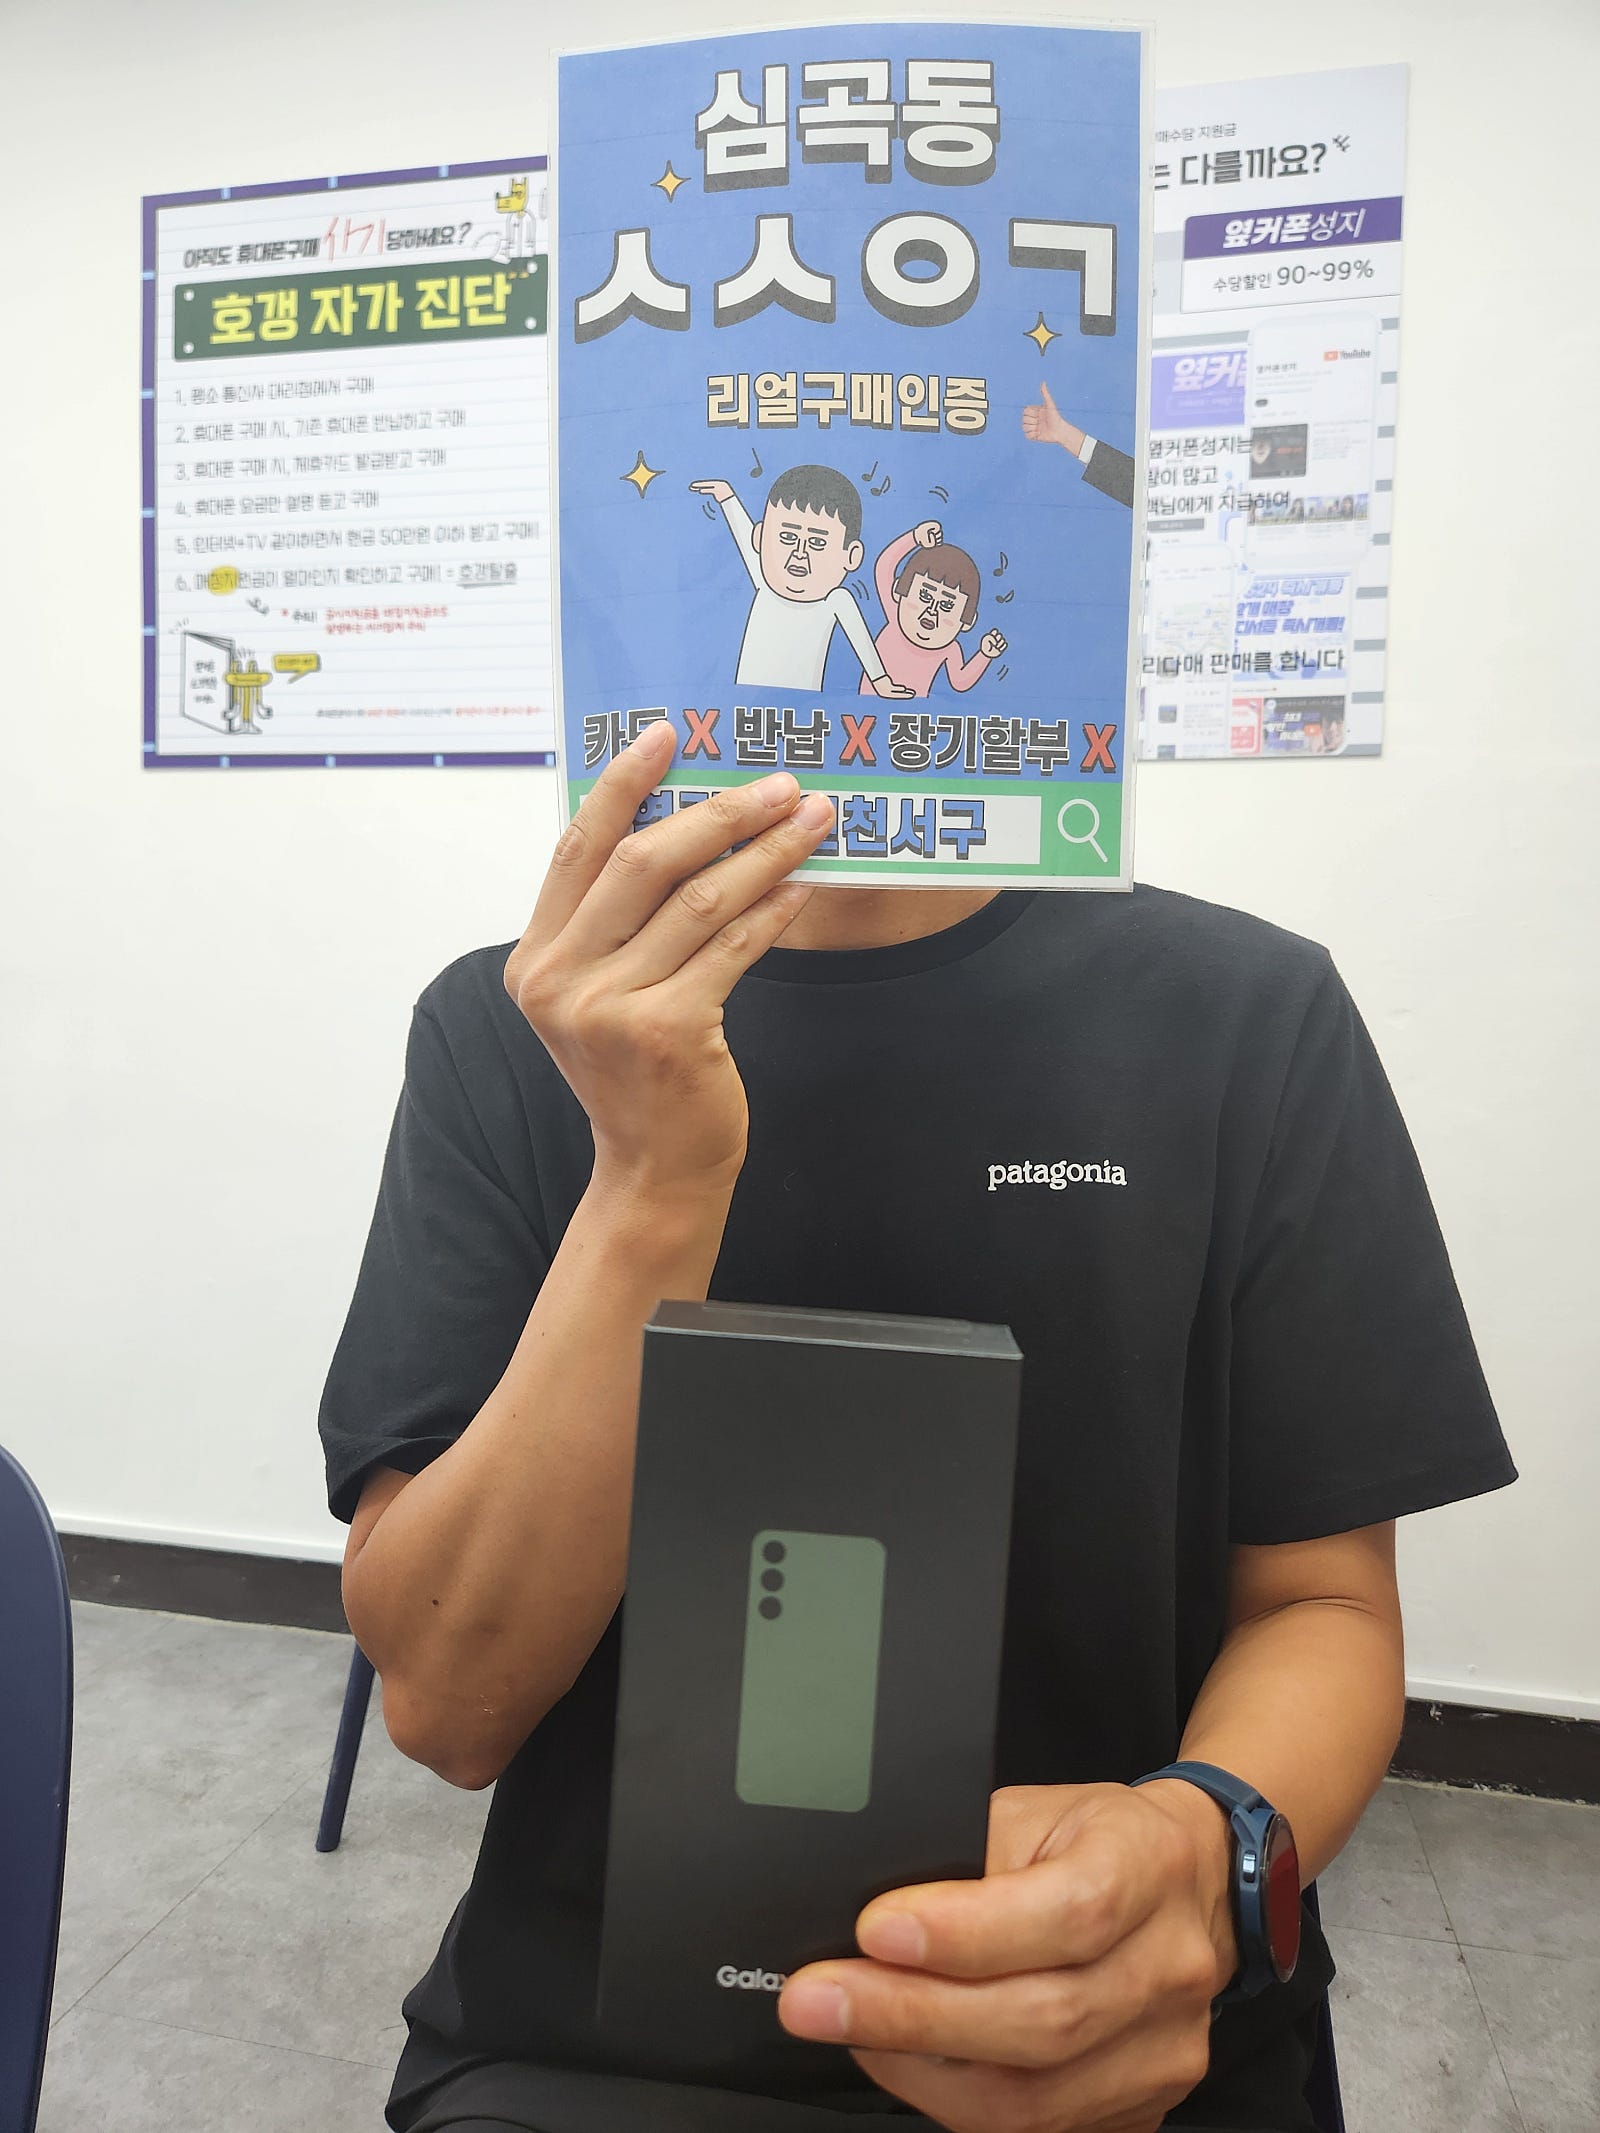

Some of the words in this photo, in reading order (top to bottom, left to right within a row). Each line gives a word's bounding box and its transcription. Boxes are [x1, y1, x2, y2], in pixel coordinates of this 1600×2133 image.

[695, 59, 1000, 193] 심곡동
[1180, 142, 1328, 185] 다를까요?
[1222, 207, 1367, 249] 옆커폰성지
[1213, 272, 1271, 293] 수당할인
[1277, 258, 1375, 286] 90~99%
[209, 288, 299, 344] 호갱
[310, 280, 404, 336] 자가
[415, 272, 512, 330] 진단
[346, 375, 375, 394] 구매
[707, 372, 990, 433] 리얼구매인증
[239, 421, 267, 440] 구매
[437, 408, 466, 428] 구매
[239, 458, 267, 477] 구매
[416, 447, 447, 467] 구매
[1183, 465, 1218, 486] 많고
[350, 489, 380, 509] 구매
[1210, 651, 1272, 675] 판매를
[1279, 649, 1345, 673] 합니다
[682, 709, 721, 760] X
[733, 706, 831, 768] 반납
[839, 714, 878, 767] X
[888, 713, 1069, 776] 장기할부
[1079, 723, 1117, 774] X
[988, 1159, 1127, 1191] patagonia
